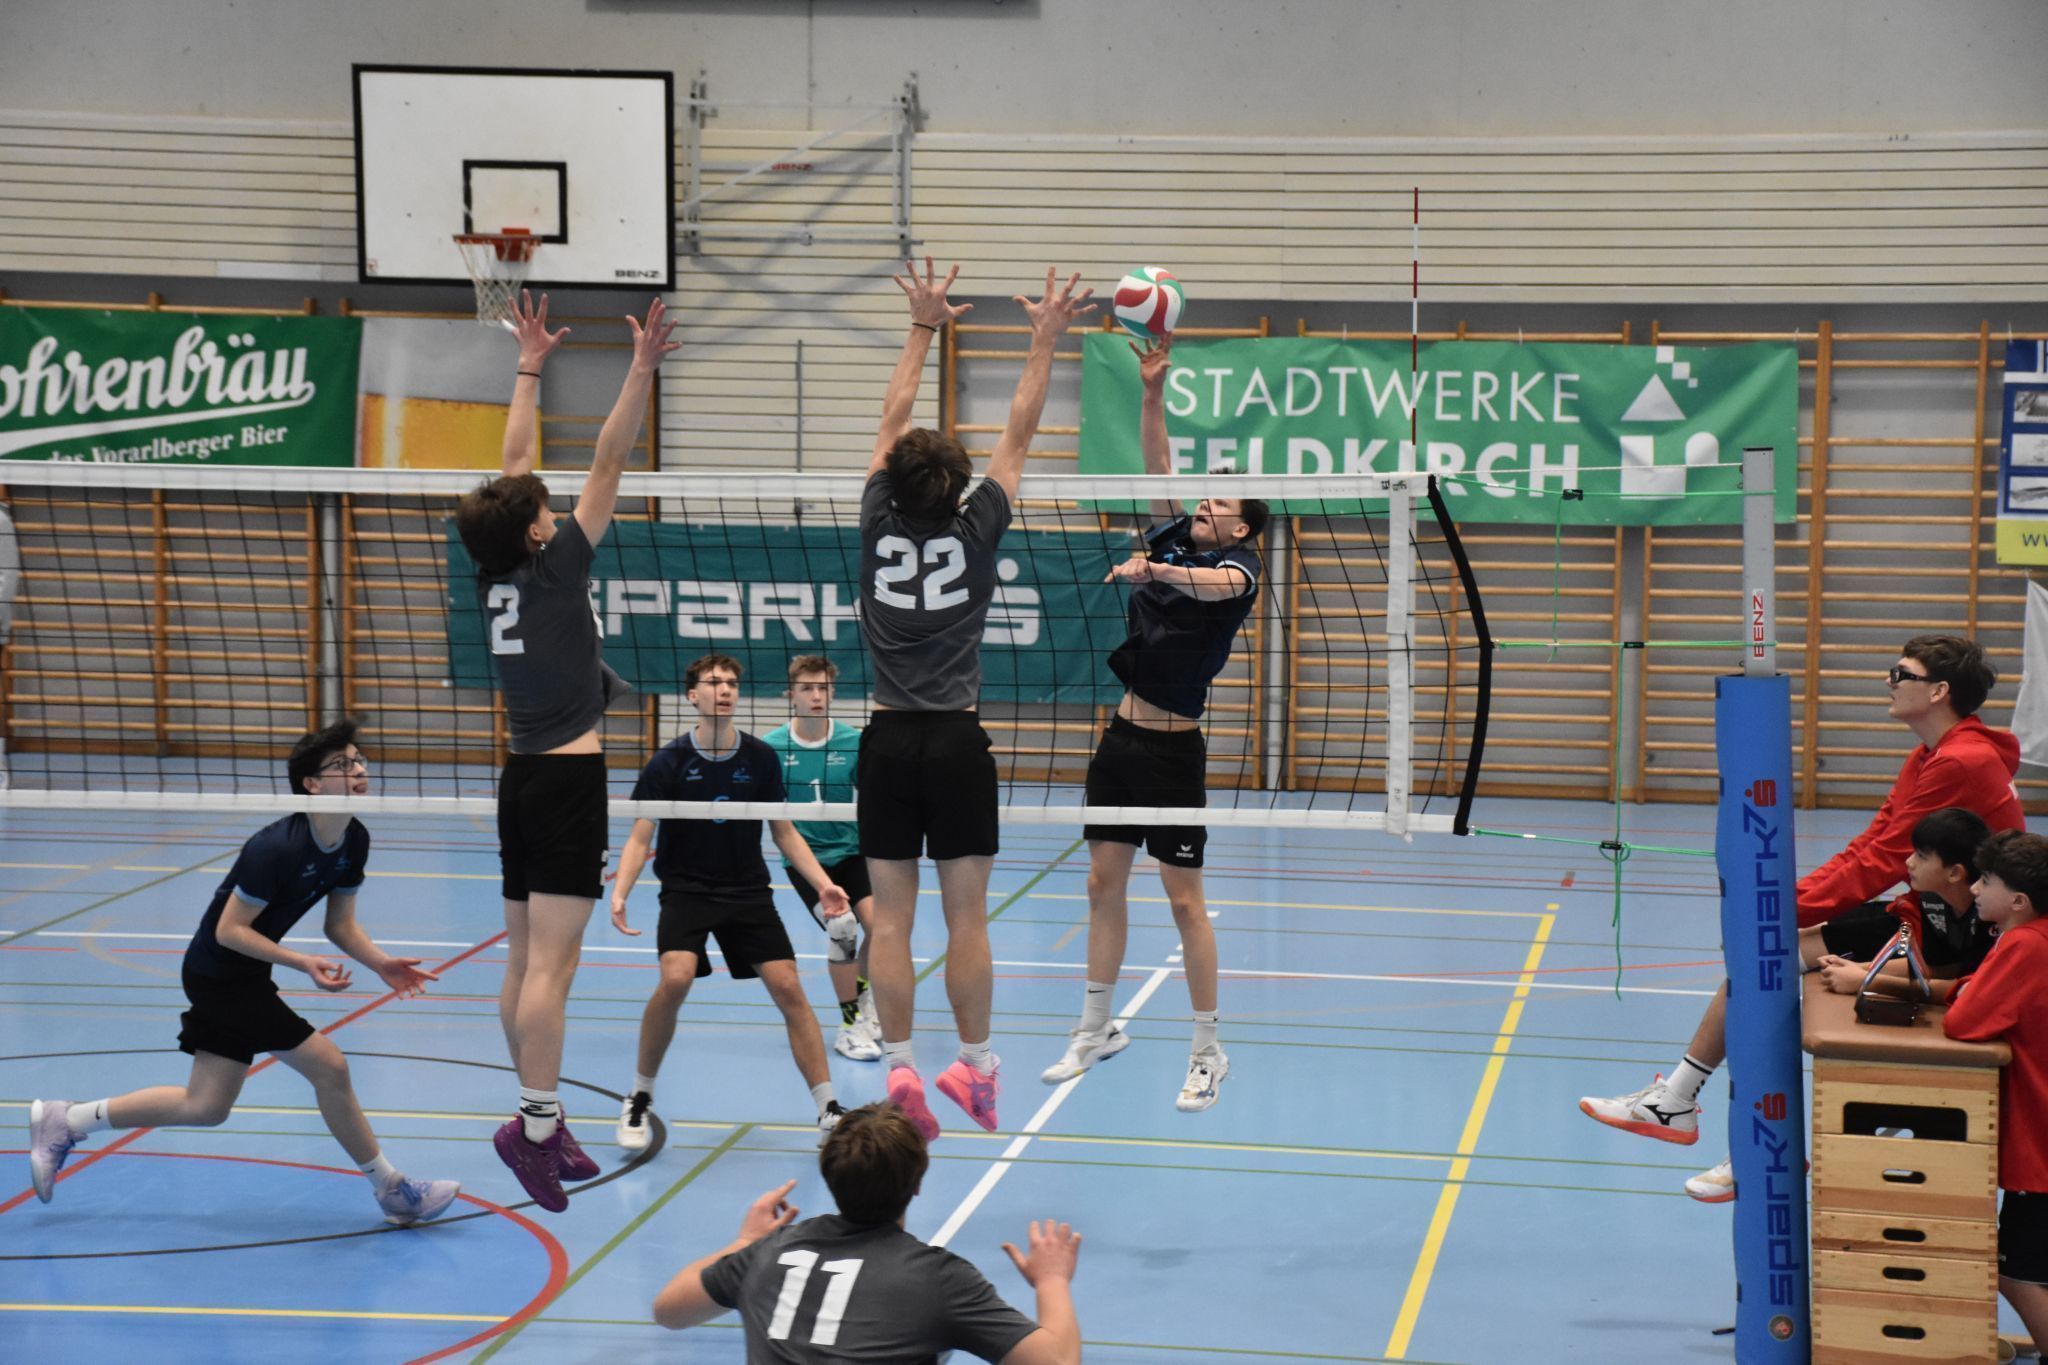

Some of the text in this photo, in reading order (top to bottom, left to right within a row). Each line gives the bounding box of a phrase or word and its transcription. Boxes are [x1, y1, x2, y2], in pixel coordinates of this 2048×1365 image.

[615, 269, 660, 278] BENZ
[1166, 365, 1582, 424] STADTWERKE
[240, 424, 288, 447] Bier
[873, 535, 970, 611] 22
[487, 584, 525, 654] 2
[1752, 593, 1765, 658] BENZ
[1743, 803, 1790, 992] spark7
[1753, 1115, 1801, 1307] spark7
[767, 1249, 863, 1346] 11
